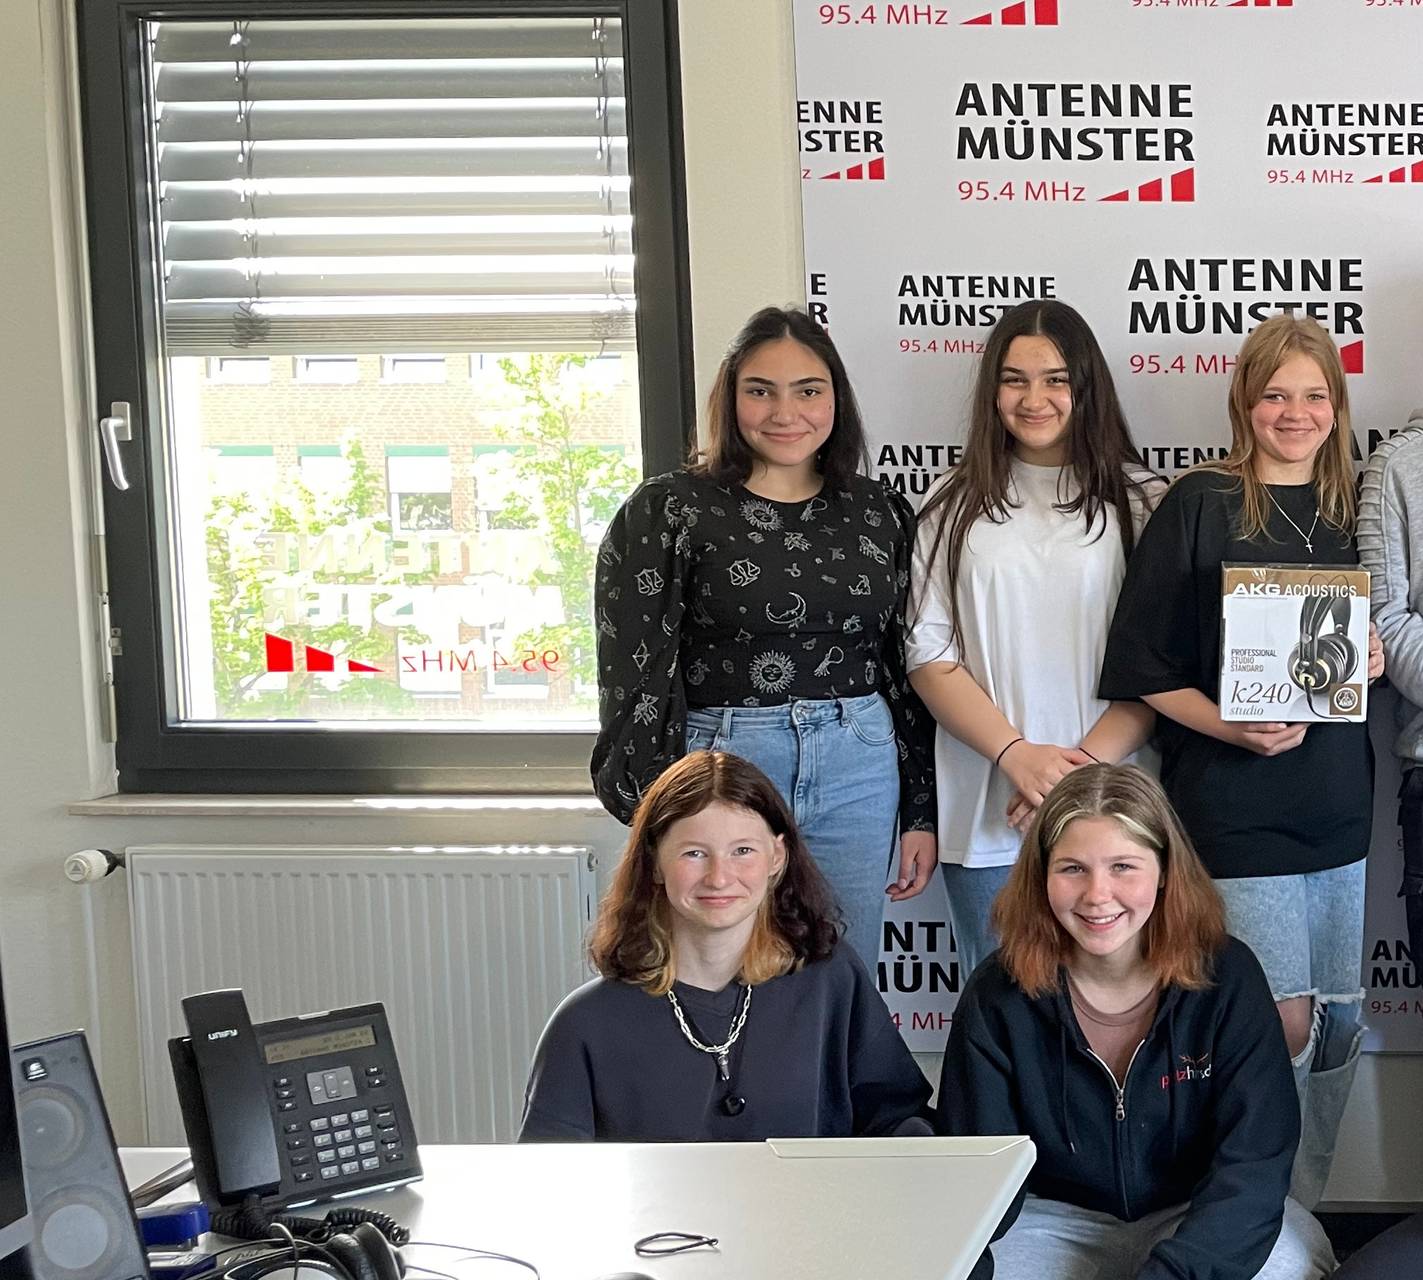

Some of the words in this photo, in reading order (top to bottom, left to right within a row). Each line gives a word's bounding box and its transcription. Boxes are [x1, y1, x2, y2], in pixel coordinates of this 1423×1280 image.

[819, 4, 878, 25] 95.4
[885, 3, 949, 25] MHz
[956, 83, 1192, 118] ANTENNE
[797, 101, 883, 123] ENNE
[798, 130, 884, 153] STER
[956, 119, 1194, 161] MÜNSTER
[1267, 169, 1306, 184] 95.4
[1312, 169, 1354, 184] MHz
[958, 181, 1016, 202] 95.4
[1024, 181, 1086, 202] MHz
[1128, 258, 1364, 292] ANTENNE
[898, 275, 1057, 299] ANTENNE
[900, 339, 938, 353] 95.4
[944, 339, 985, 354] MHz
[1130, 355, 1186, 374] 95.4
[1196, 354, 1240, 374] MH
[1231, 583, 1281, 596] AKG
[1284, 584, 1357, 598] ACOUSTICS
[1231, 648, 1277, 657] PROFESSIONAL
[1230, 664, 1264, 672] STANDARD
[1230, 680, 1292, 704] k240
[1229, 704, 1264, 716] studio
[1371, 1000, 1408, 1014] 95.4
[912, 1012, 953, 1030] MH
